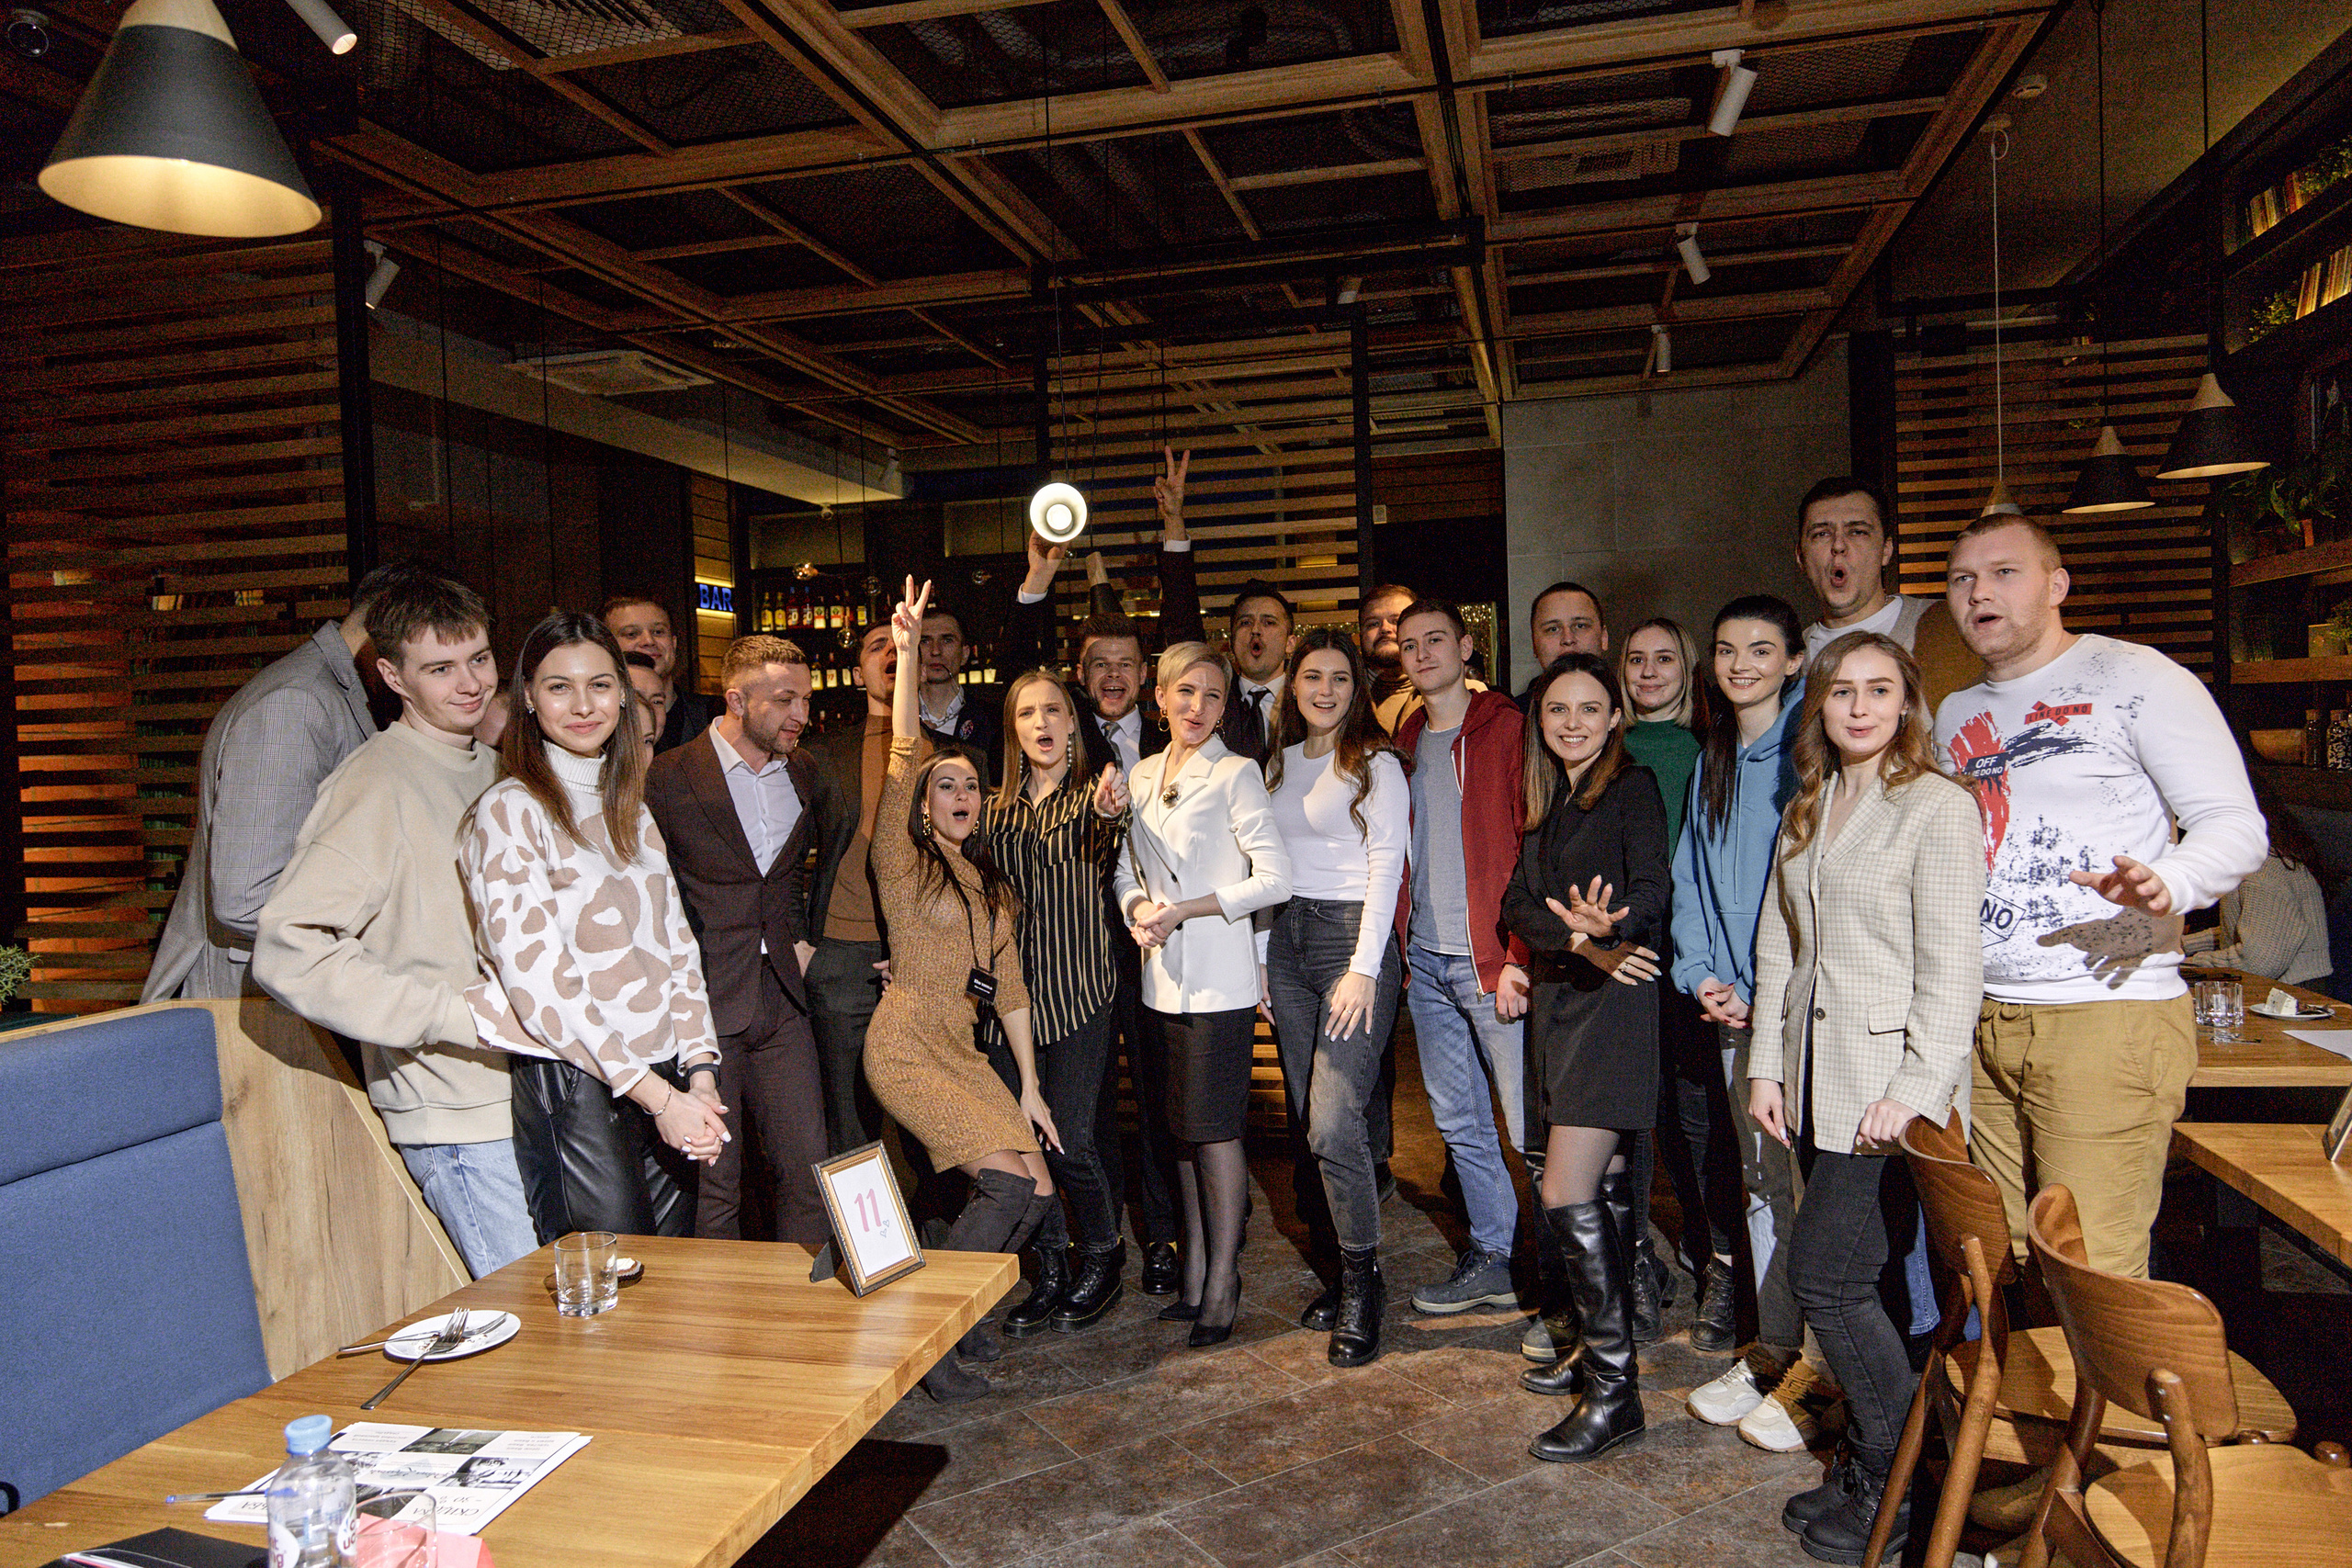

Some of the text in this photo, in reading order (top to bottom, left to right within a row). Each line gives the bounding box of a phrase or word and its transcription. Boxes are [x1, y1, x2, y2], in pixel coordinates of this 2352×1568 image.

[699, 583, 733, 612] BAR
[2029, 709, 2052, 722] LINE
[2054, 706, 2070, 716] DO
[2073, 705, 2087, 714] NO
[1975, 756, 1997, 769] OFF
[1980, 768, 1992, 776] DO
[1992, 766, 2004, 774] NO
[1980, 897, 2014, 930] NO
[854, 1188, 882, 1233] 11
